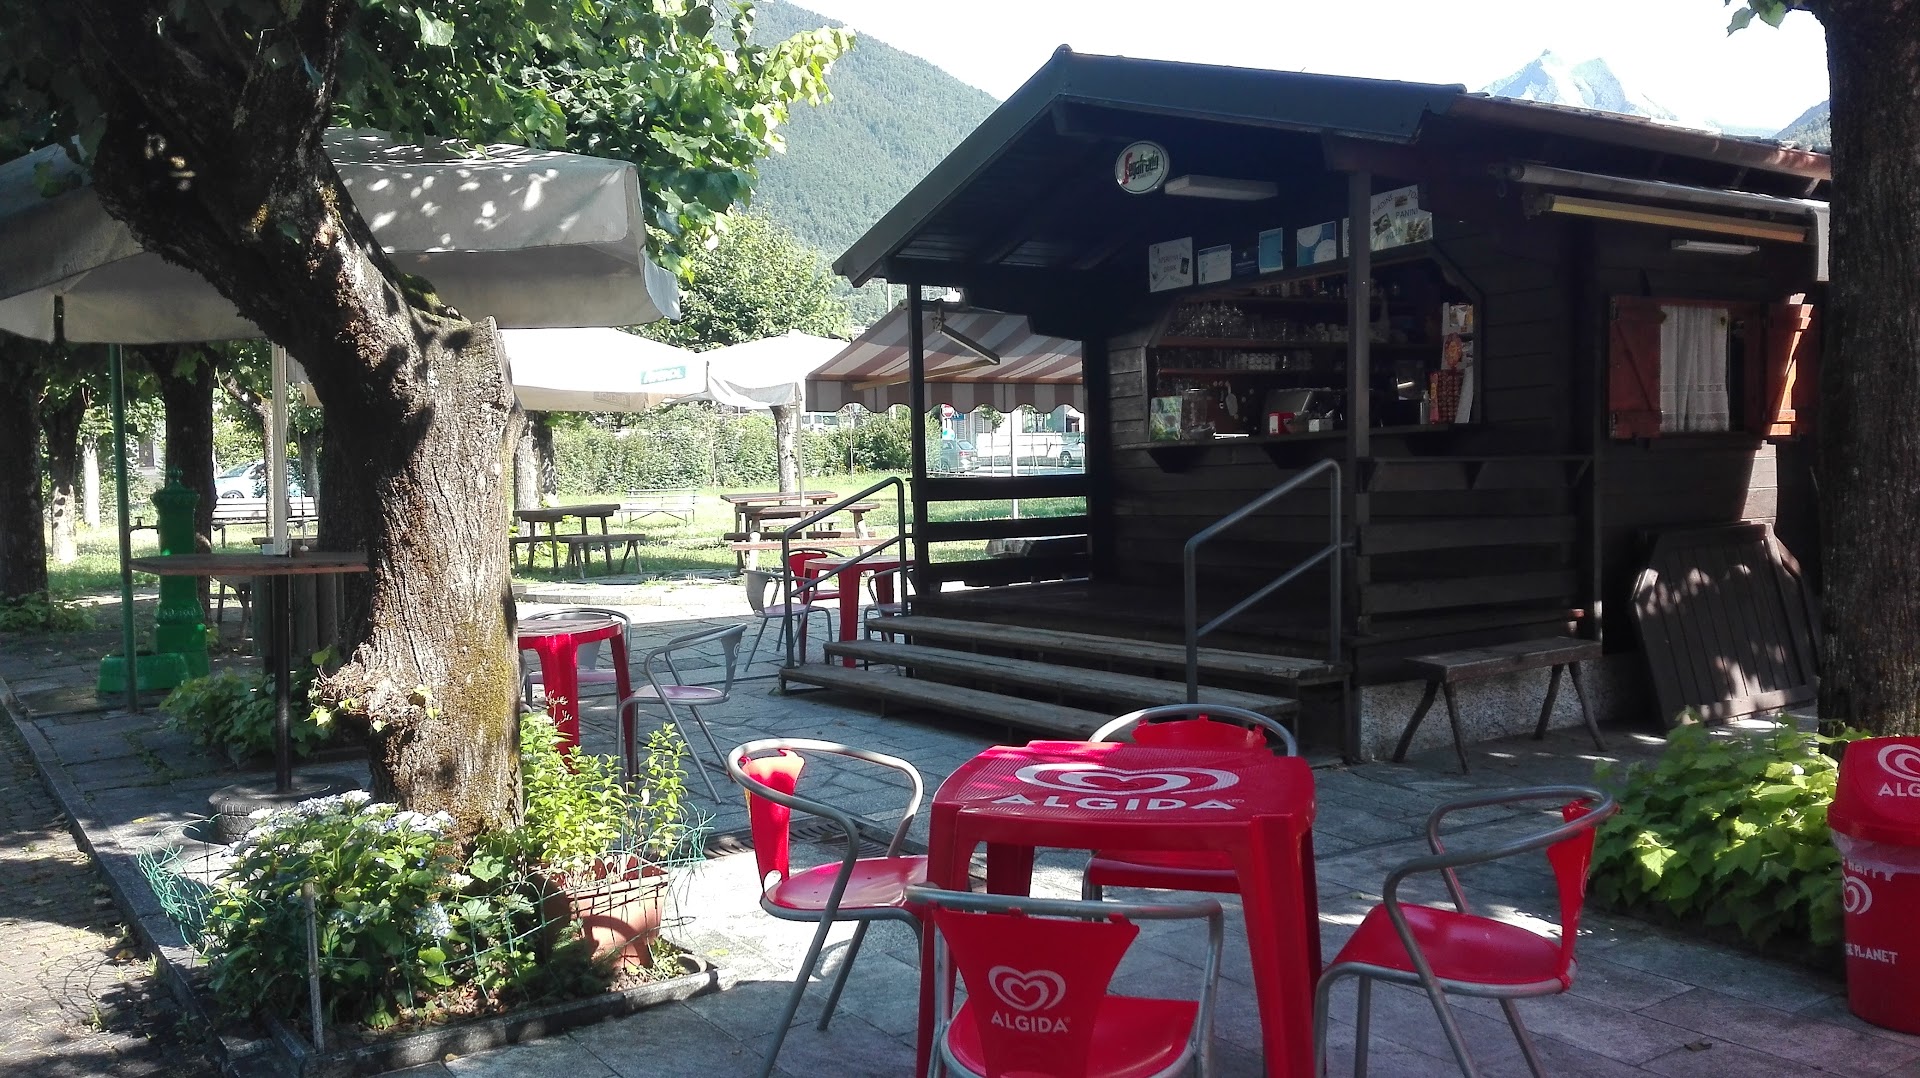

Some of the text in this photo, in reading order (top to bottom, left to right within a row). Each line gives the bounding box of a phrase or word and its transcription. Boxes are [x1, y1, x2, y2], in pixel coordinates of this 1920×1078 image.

[1395, 207, 1419, 219] PANINI
[991, 794, 1237, 811] ALGIDA
[1853, 943, 1899, 965] PLANET
[991, 1010, 1069, 1034] ALGIDA
